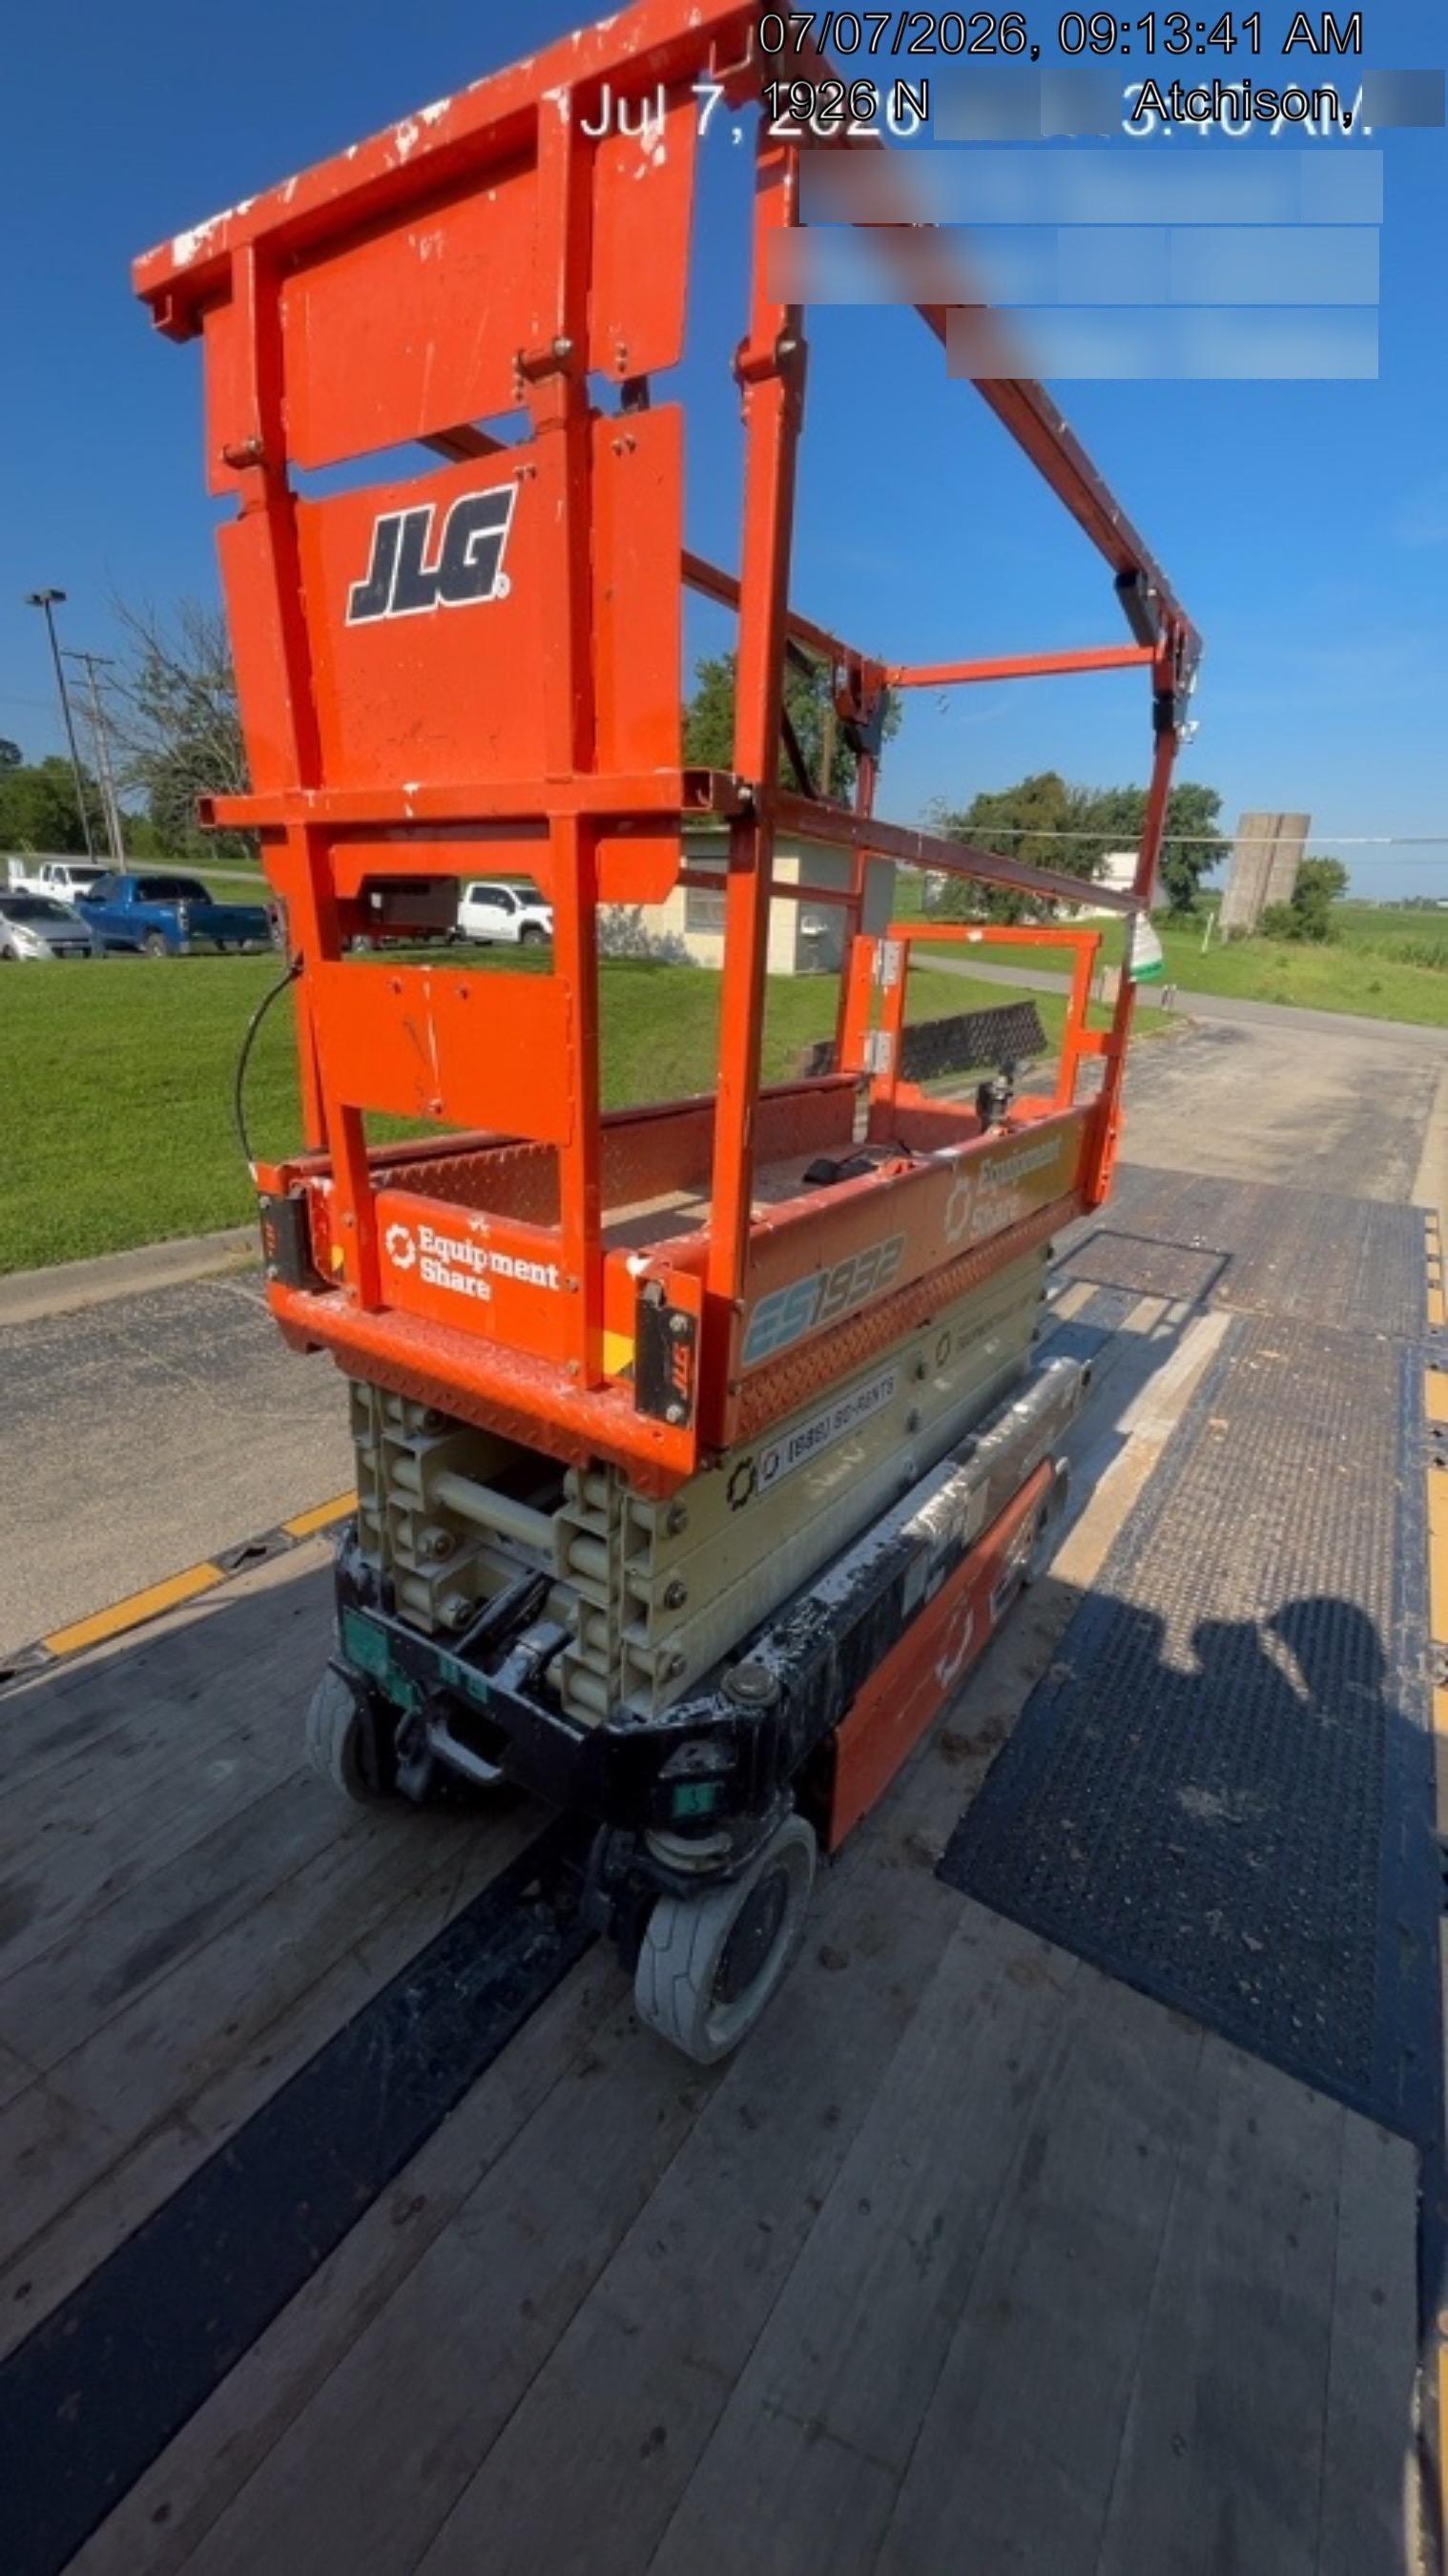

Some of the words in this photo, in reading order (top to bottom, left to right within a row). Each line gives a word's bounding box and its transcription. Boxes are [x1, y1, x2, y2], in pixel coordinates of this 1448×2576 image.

[345, 481, 519, 627] JLG
[417, 1224, 560, 1291] Equipment
[420, 1255, 492, 1301] Share
[740, 1231, 907, 1368] ES1932
